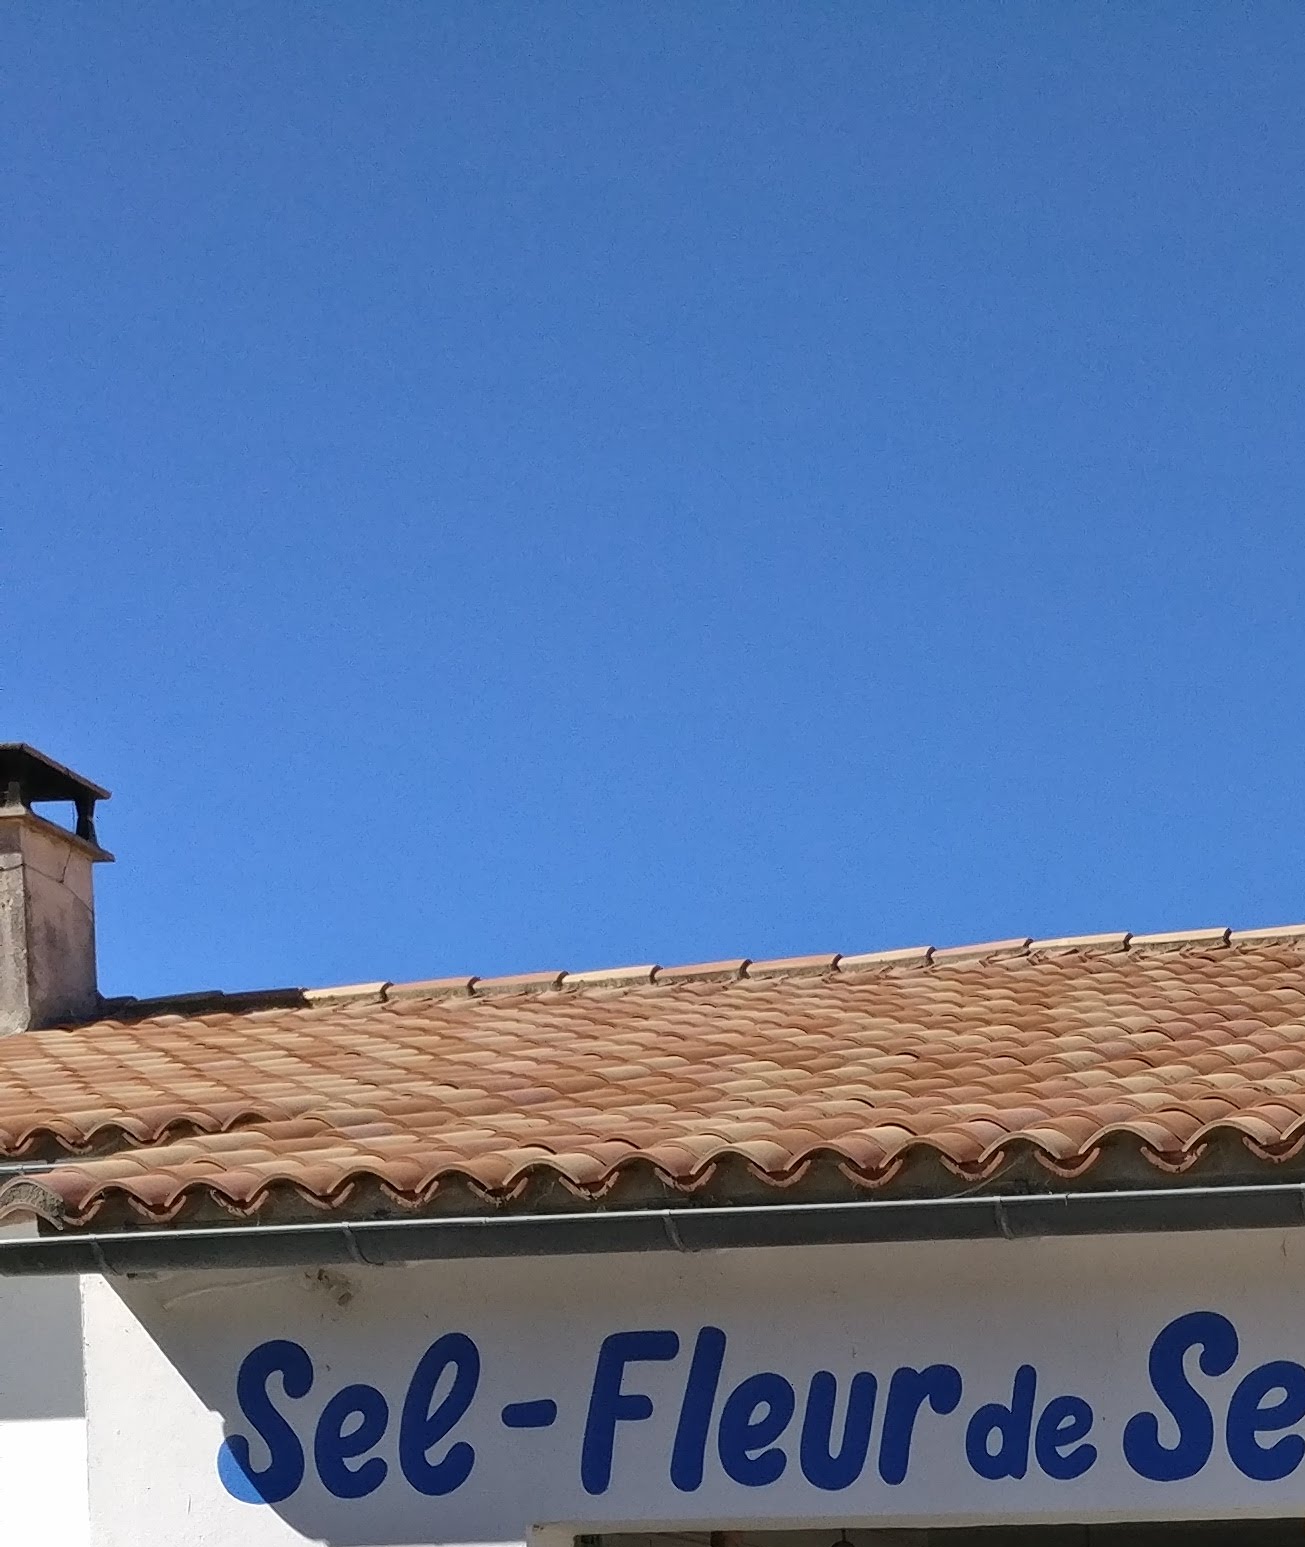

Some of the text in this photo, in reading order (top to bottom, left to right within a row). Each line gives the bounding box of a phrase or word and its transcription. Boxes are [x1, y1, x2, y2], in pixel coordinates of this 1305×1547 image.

[218, 1331, 480, 1505] Sel
[580, 1325, 962, 1495] Fleur
[965, 1363, 1098, 1482] de
